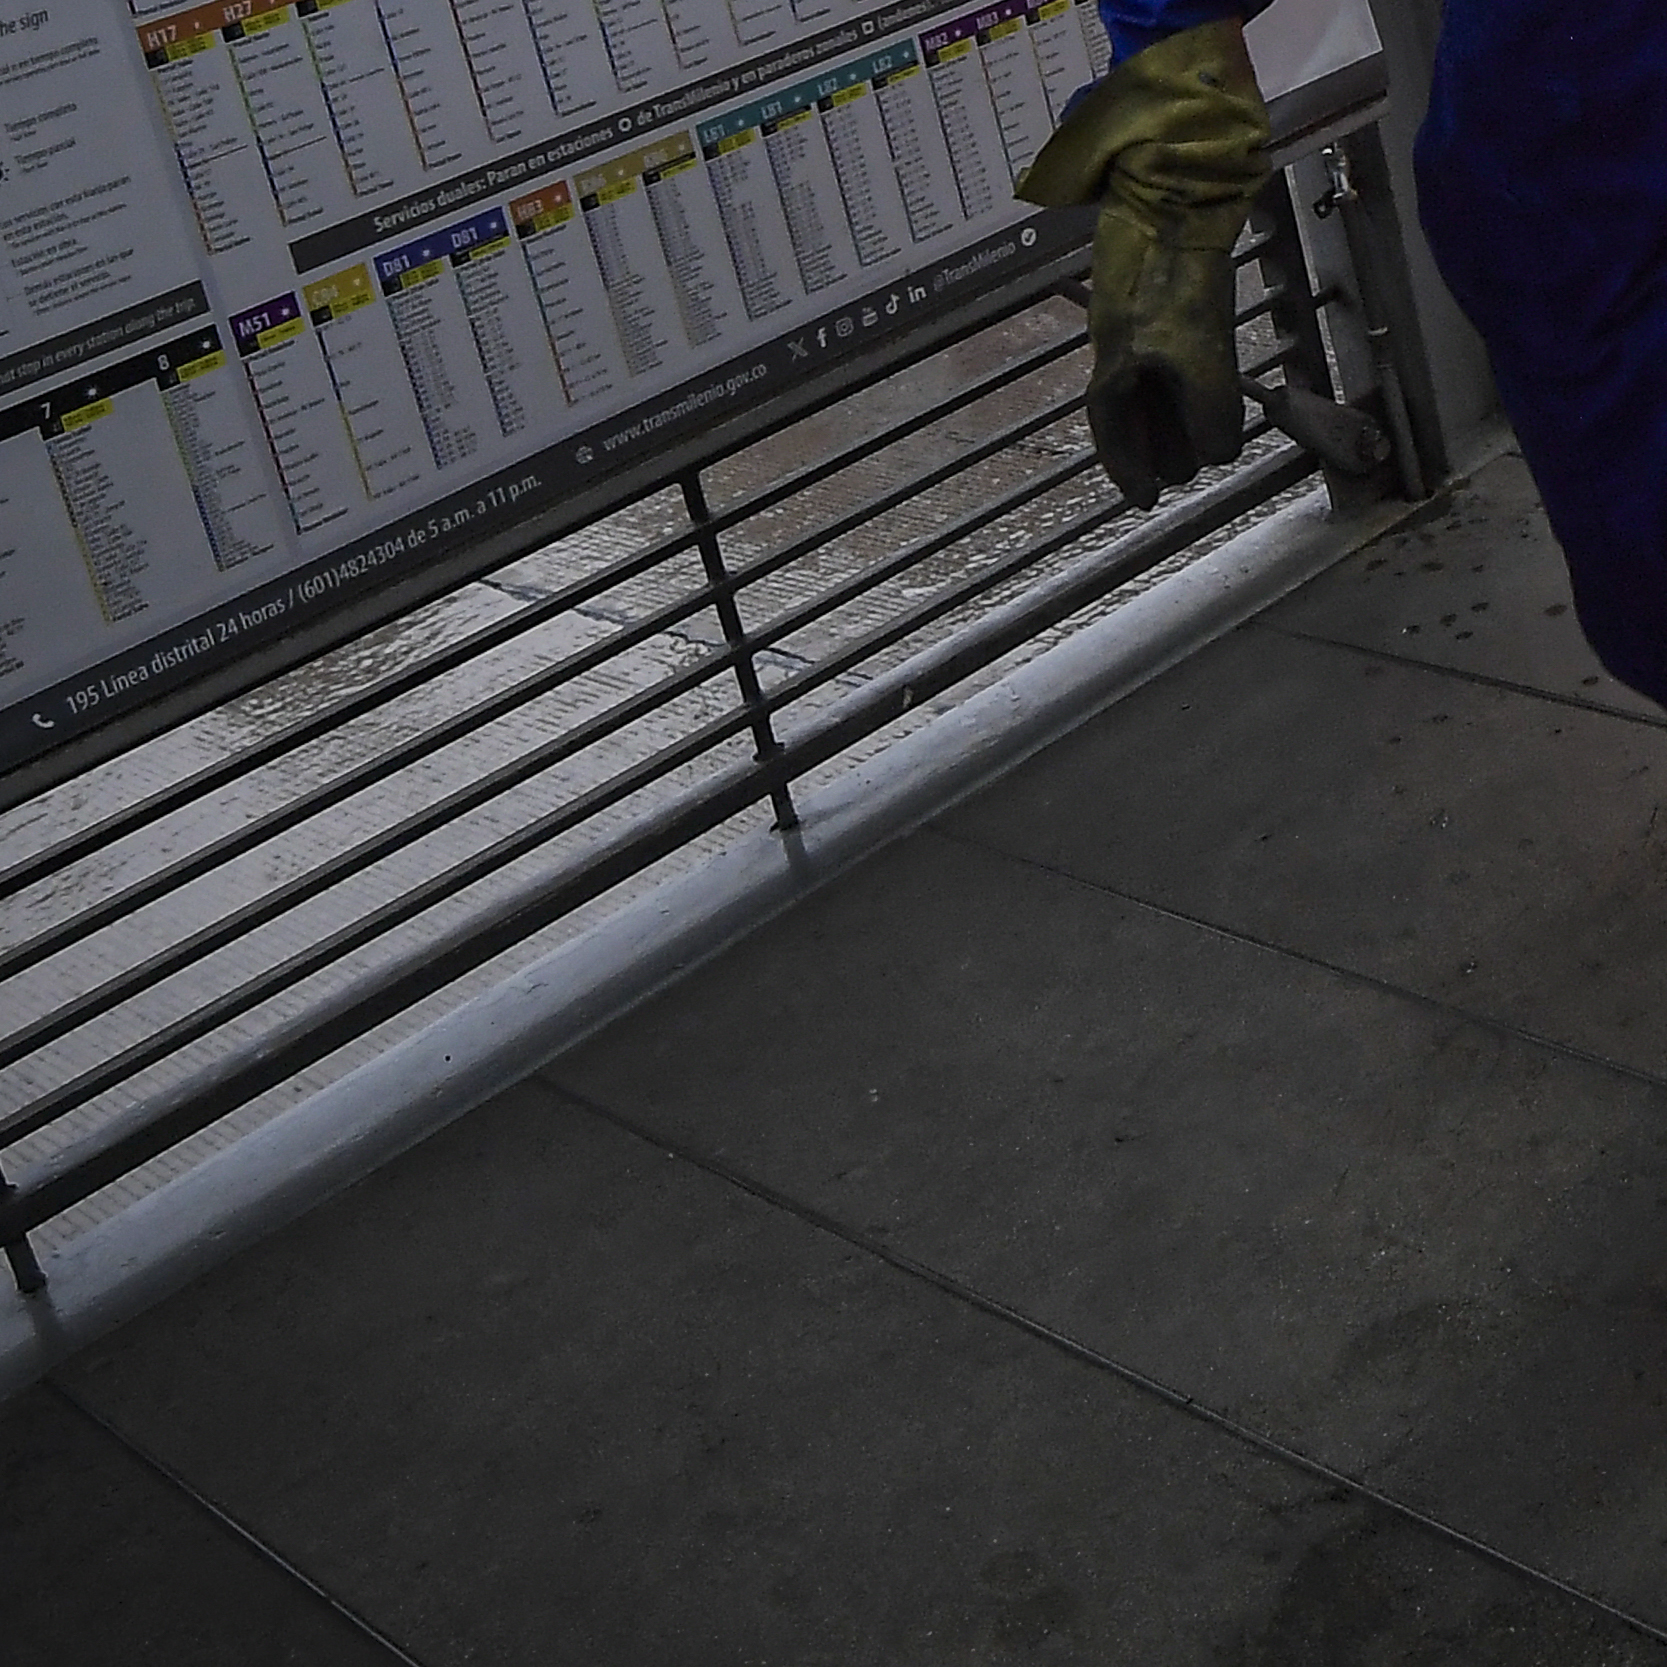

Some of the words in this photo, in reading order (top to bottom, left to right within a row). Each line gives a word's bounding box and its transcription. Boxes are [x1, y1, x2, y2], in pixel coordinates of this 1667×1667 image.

[20, 9, 48, 31] sign
[147, 25, 178, 48] H17
[374, 198, 435, 232] Servicios
[437, 178, 484, 207] duales:
[487, 161, 526, 186] Paran
[528, 153, 546, 171] en
[548, 126, 614, 164] estaciones
[637, 110, 653, 127] de
[157, 306, 172, 321] the
[239, 312, 271, 336] M51
[157, 354, 170, 371] 8
[41, 402, 51, 419] 7
[602, 362, 768, 451] www.transmilenio.gov.co
[66, 687, 100, 715] 195
[100, 664, 149, 699] Línea
[151, 628, 215, 674] distrital
[217, 617, 239, 643] 24
[240, 597, 286, 630] horas
[299, 537, 405, 604] (601)4824304
[408, 528, 426, 549] de
[428, 518, 439, 539] 5
[442, 507, 475, 533] a.m.
[477, 499, 487, 514] a
[488, 487, 507, 509] 11
[509, 474, 542, 503] p.m.
